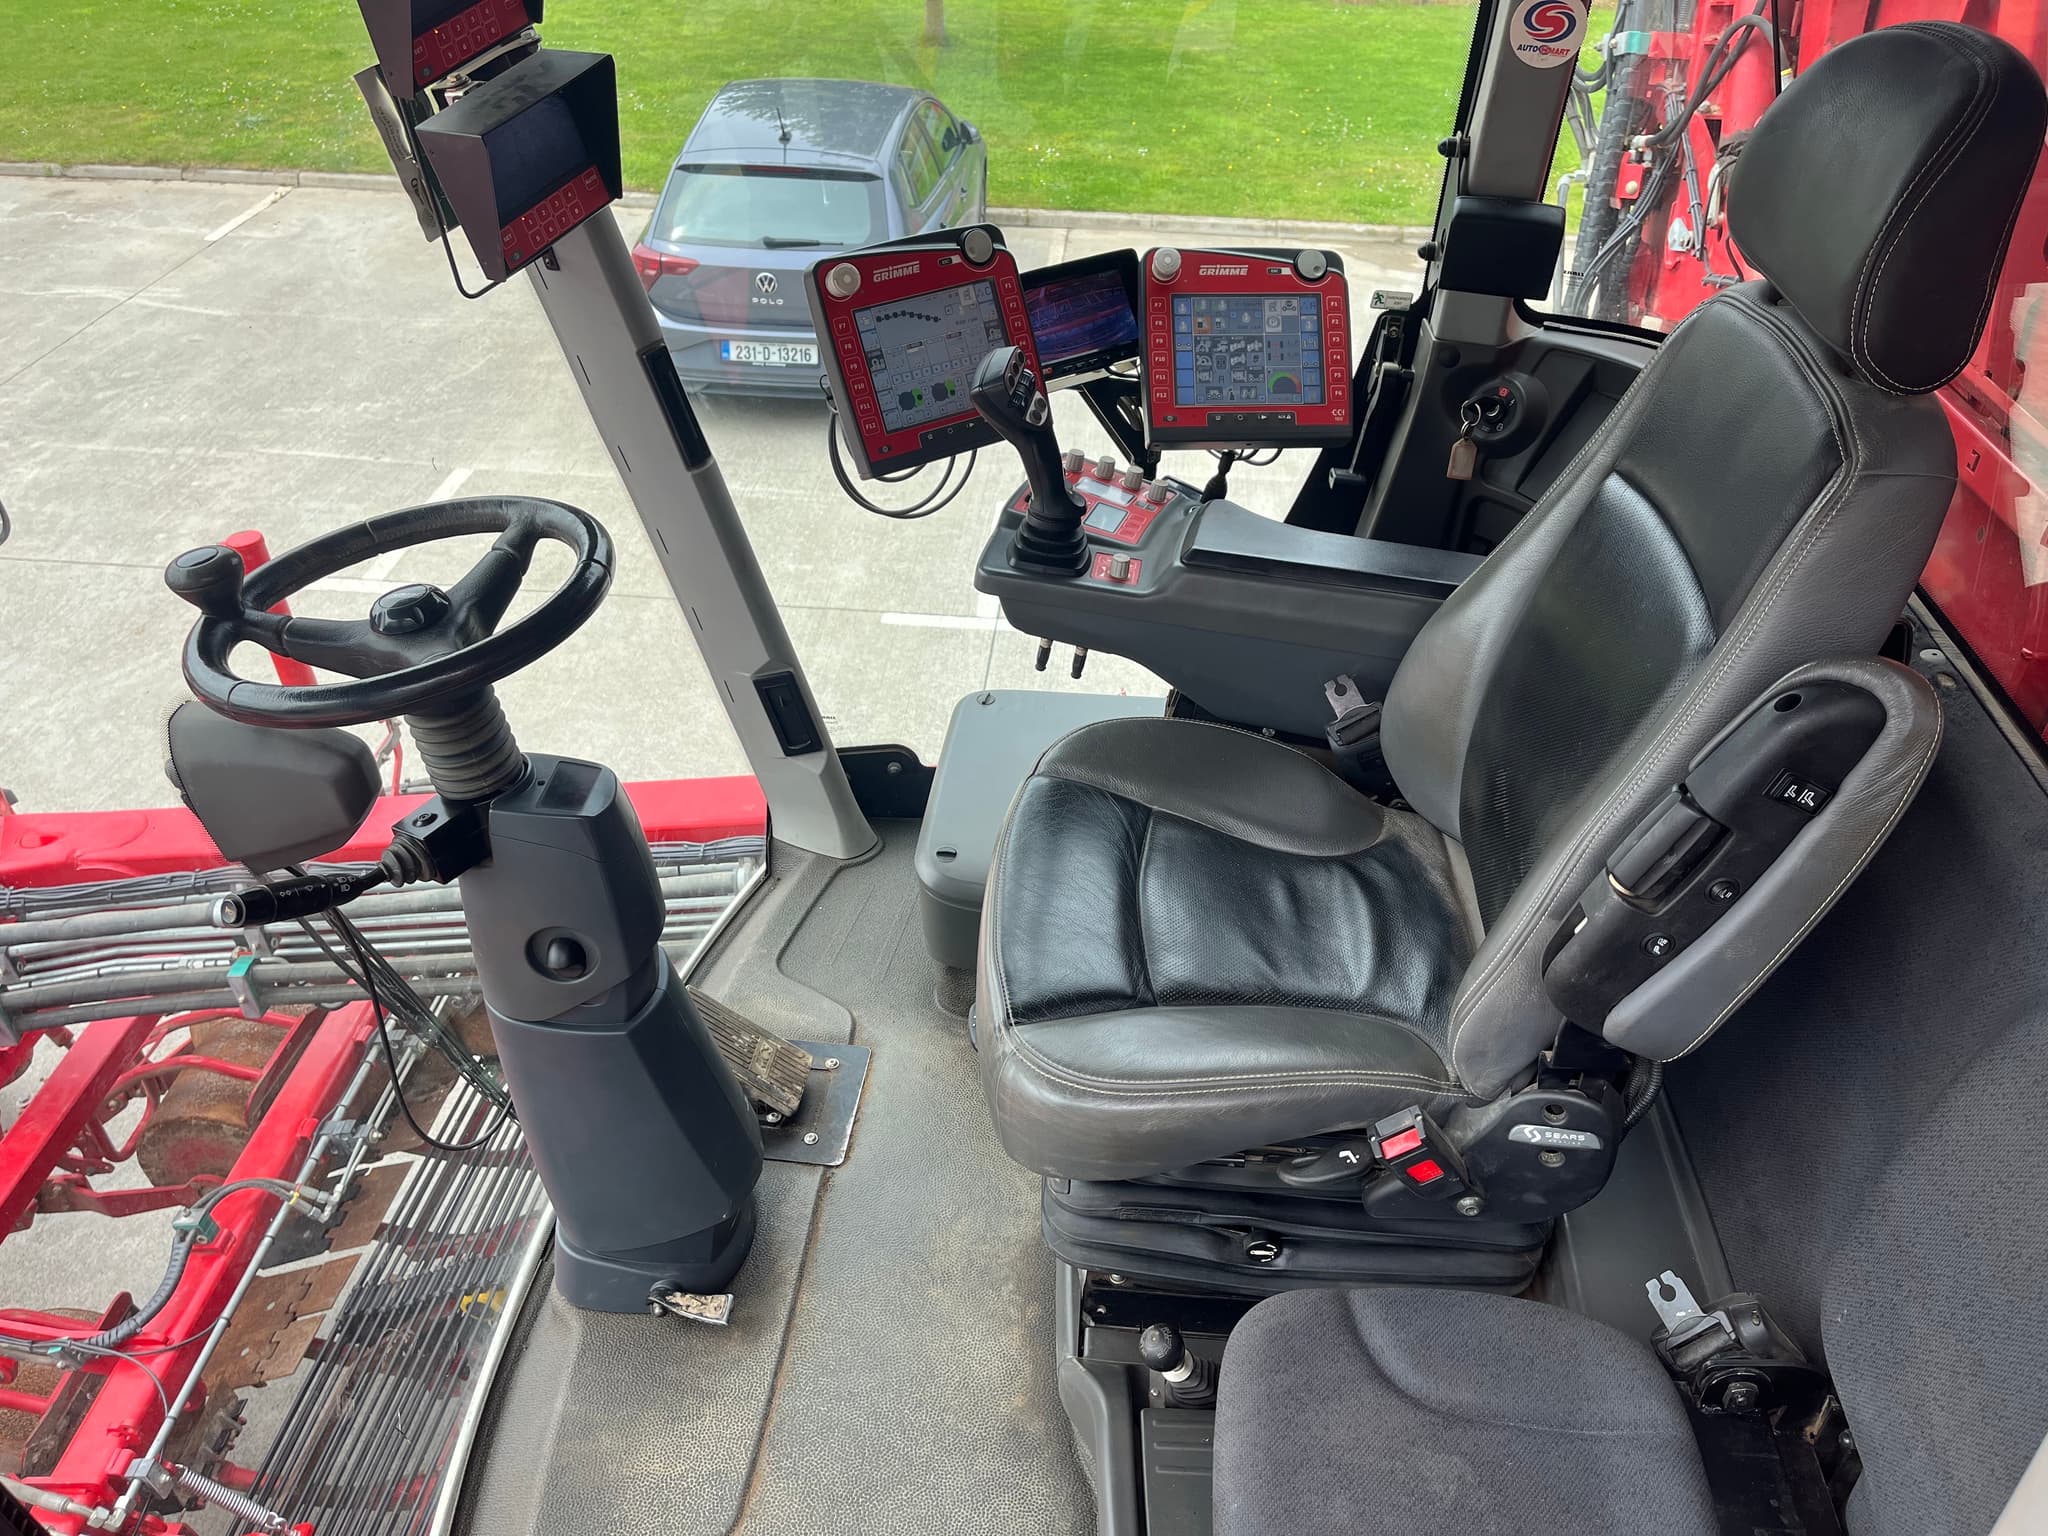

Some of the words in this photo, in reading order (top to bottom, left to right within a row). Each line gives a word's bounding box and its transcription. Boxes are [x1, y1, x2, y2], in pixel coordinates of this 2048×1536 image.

[873, 261, 920, 282] GRIMME
[1199, 264, 1248, 276] GRIMME
[736, 344, 812, 362] 231-D-13216
[1545, 1131, 1585, 1141] SEARS
